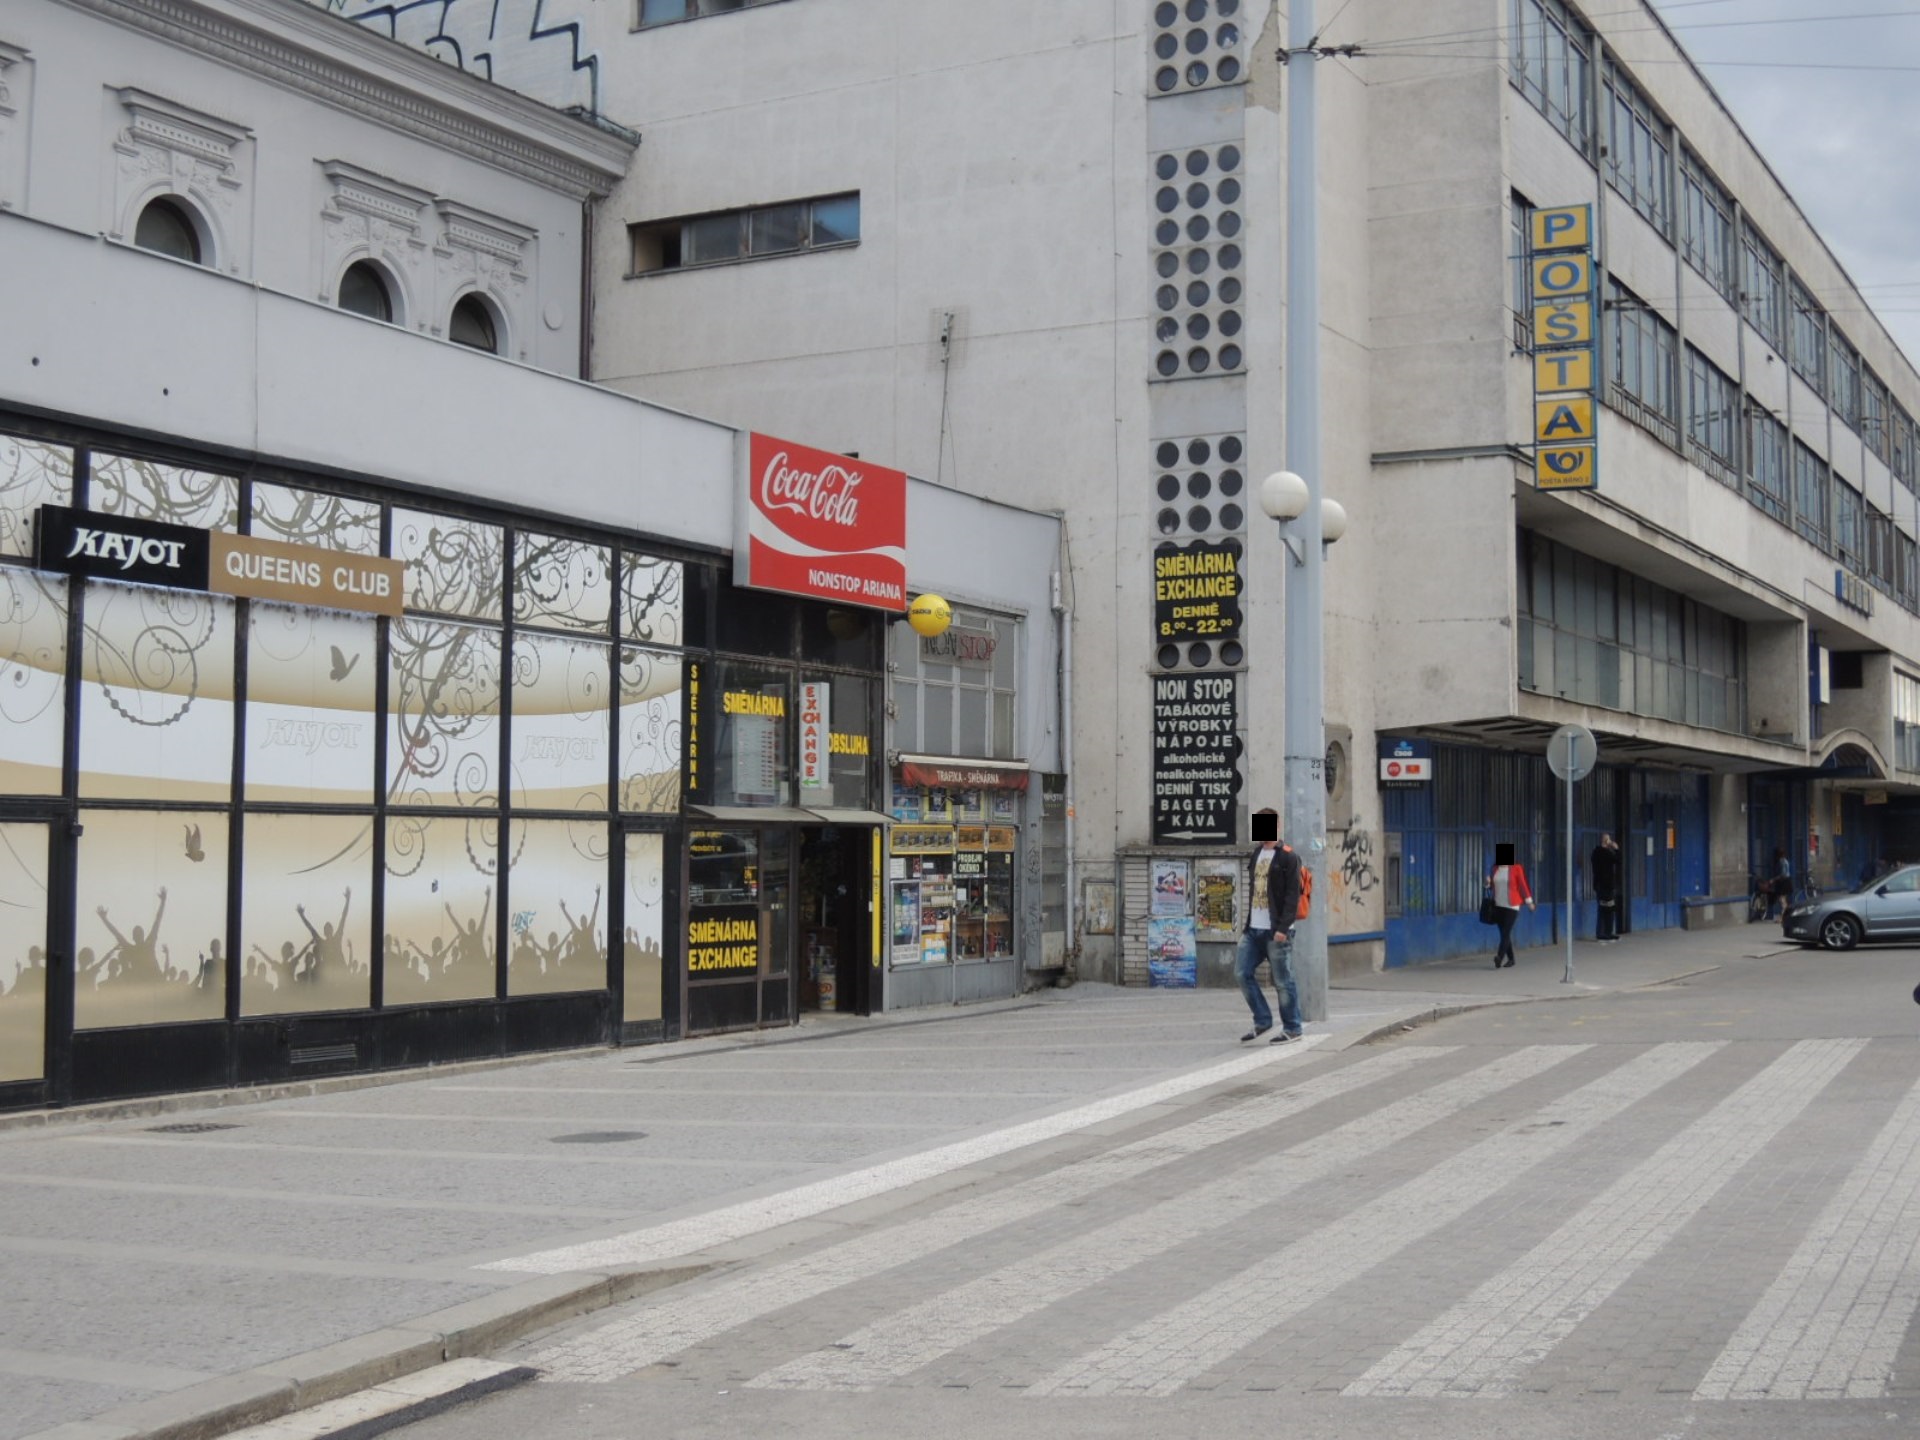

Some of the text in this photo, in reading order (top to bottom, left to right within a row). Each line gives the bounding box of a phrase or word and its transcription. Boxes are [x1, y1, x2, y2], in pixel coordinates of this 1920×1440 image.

[1540, 213, 1583, 436] POŠTA
[761, 451, 864, 527] Coca-Cola
[67, 527, 186, 571] KAJOT
[226, 551, 390, 597] QUEENS CLUB
[1156, 551, 1235, 577] SMĚNÁRNA
[808, 569, 901, 600] NONSTOP ARIANA
[1156, 575, 1236, 601] EXCHANGE
[1172, 602, 1219, 619] DENNĚ
[958, 634, 997, 661] STOP
[1157, 678, 1233, 700] NON STOP
[723, 689, 785, 718] SMĚNÁRNA
[1155, 701, 1232, 717] TABÁKOVÉ
[260, 717, 363, 757] KAJOT
[801, 685, 821, 778] EXCHANGE
[1157, 718, 1233, 733] VÝROBKY
[520, 734, 600, 768] KAJOT
[1156, 733, 1233, 749] NÁPOJE
[1163, 752, 1226, 765] alkoholické
[1311, 760, 1321, 769] 23
[1156, 767, 1233, 780] nealkoholické
[1311, 773, 1320, 781] 14
[1156, 781, 1231, 795] DENNÍ TISK
[1161, 799, 1229, 812] BAGETY
[1171, 813, 1216, 827] KÁVA
[689, 917, 757, 944] SMĚNÁRNA
[688, 945, 757, 971] EXCHANGE
